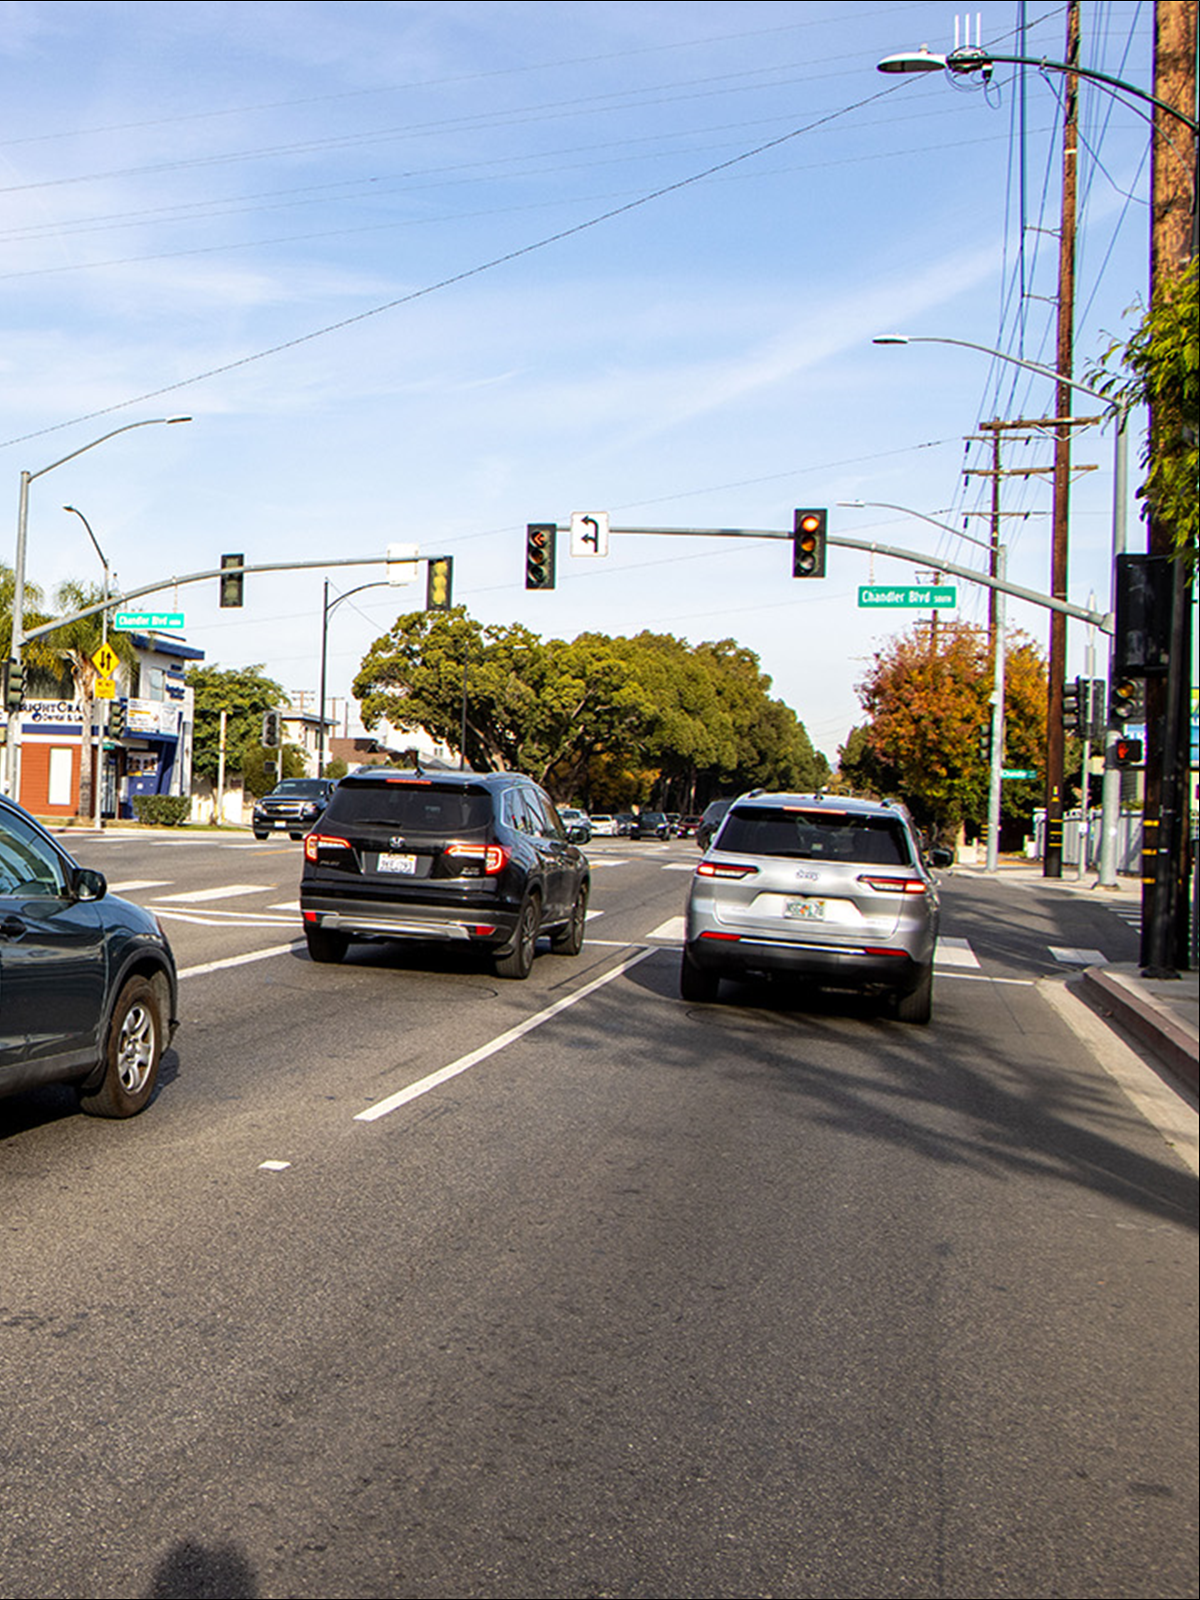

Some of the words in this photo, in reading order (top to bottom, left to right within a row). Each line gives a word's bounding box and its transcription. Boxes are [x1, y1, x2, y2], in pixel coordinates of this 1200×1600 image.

[862, 590, 905, 603] Chandler
[909, 590, 931, 603] Blvd
[119, 615, 149, 625] Chandler
[151, 615, 168, 625] Blvd
